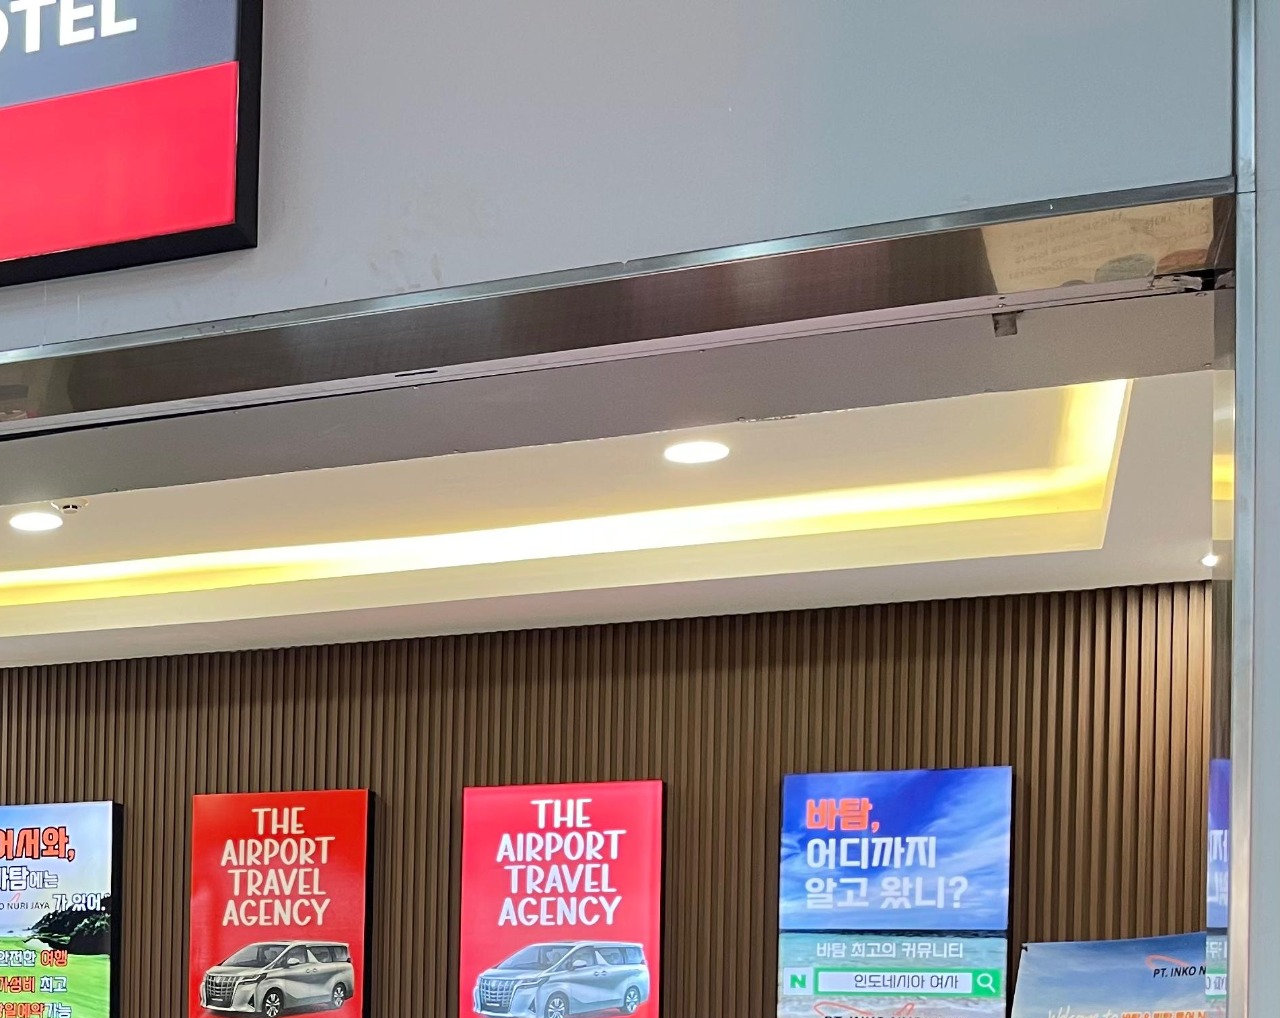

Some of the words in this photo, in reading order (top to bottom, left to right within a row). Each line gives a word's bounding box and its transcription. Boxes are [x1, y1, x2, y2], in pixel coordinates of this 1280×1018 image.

[252, 806, 305, 835] THE
[530, 798, 593, 829] THE
[806, 797, 880, 833] 바탐,
[220, 836, 335, 866] AIRPORT
[495, 830, 626, 863] AIRPORT
[806, 836, 937, 869] 어디까지
[228, 868, 326, 896] TRAVEL
[504, 863, 617, 895] TRAVEL
[805, 877, 869, 910] 알고
[880, 876, 969, 910] 왔니?
[7, 902, 28, 910] NURI
[31, 902, 50, 910] JAYA
[222, 898, 331, 927] AGENCY
[497, 895, 622, 927] AGENCY
[41, 949, 68, 967] 여행
[817, 942, 846, 958] 바탐
[851, 942, 897, 958] 최고의
[902, 942, 964, 958] 커뮤니티
[1153, 968, 1168, 978] PT.
[1170, 966, 1196, 977] INKO
